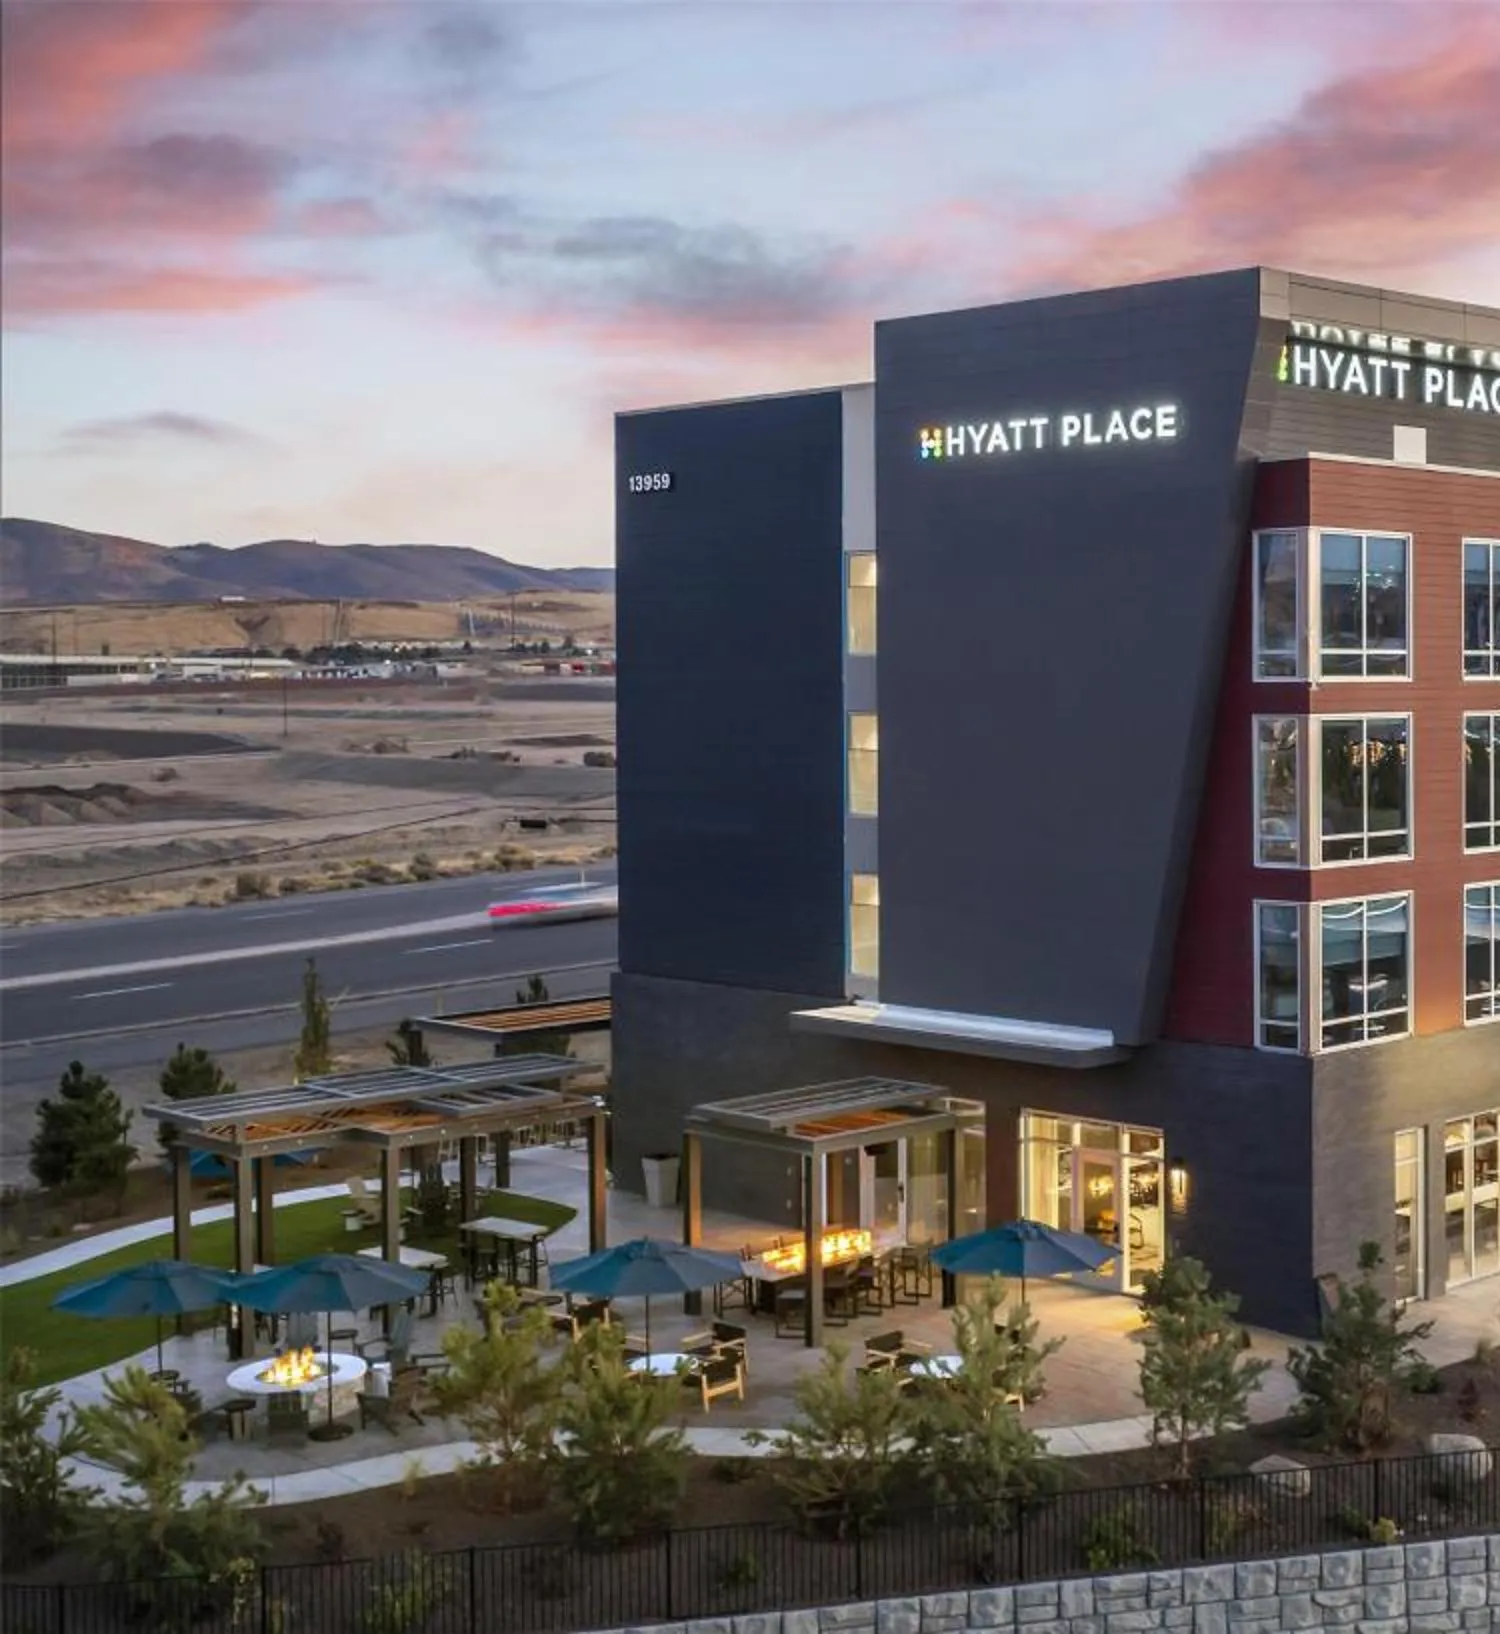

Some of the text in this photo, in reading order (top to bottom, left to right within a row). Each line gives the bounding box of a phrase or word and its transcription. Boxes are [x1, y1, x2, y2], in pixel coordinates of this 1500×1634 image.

[1293, 344, 1411, 399] HYATT
[946, 405, 1178, 456] HYATT PLACE
[629, 473, 671, 492] 13959
